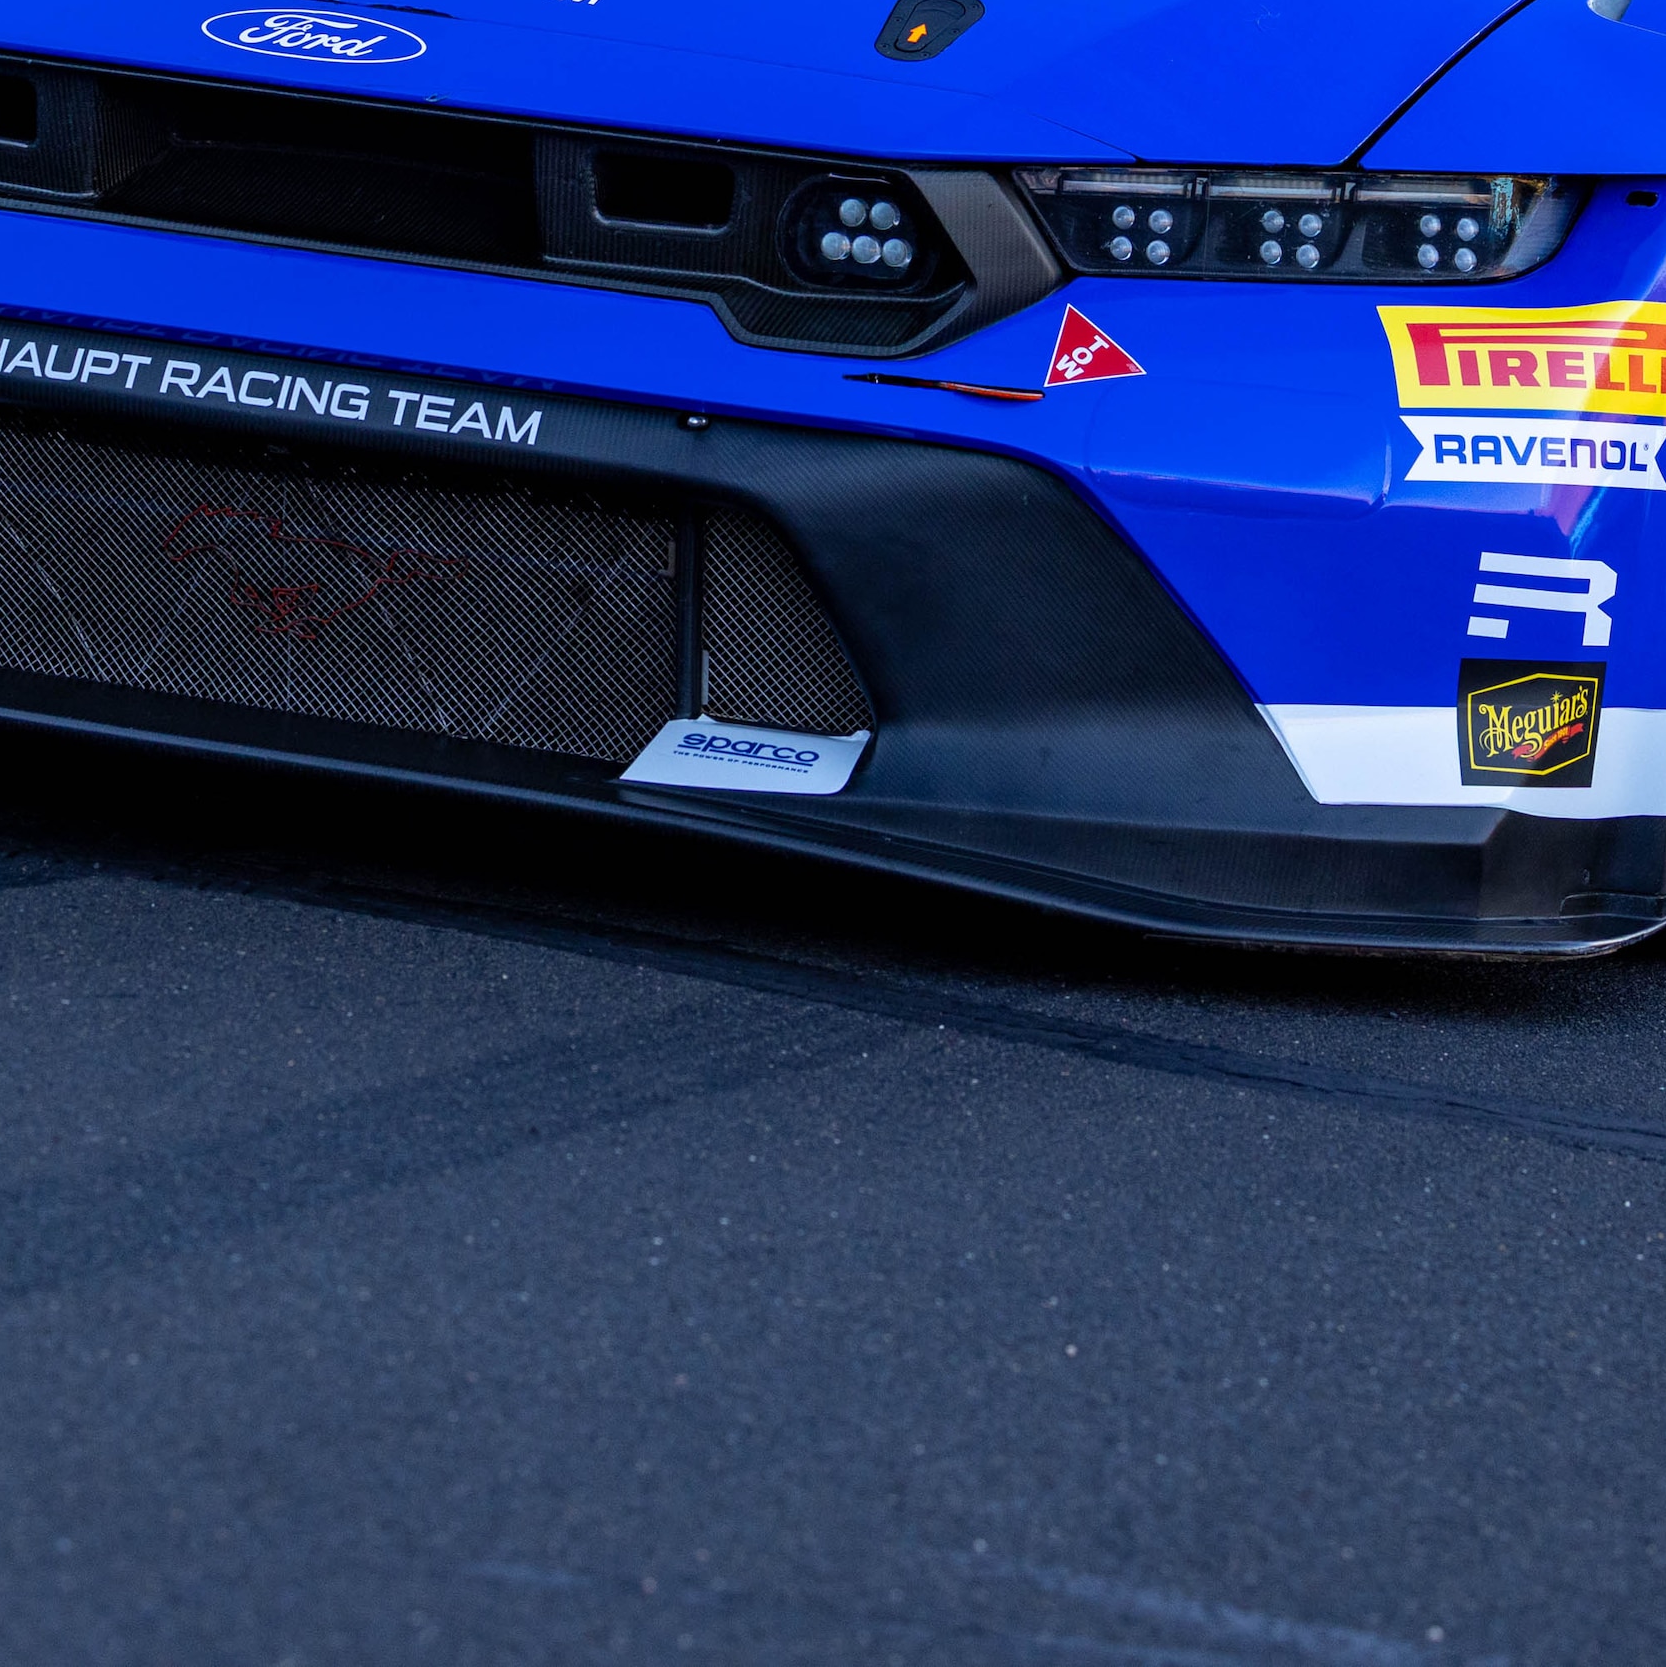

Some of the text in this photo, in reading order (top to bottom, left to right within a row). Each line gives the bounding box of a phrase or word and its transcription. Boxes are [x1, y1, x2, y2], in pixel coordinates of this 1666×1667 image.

[261, 9, 383, 58] Ford
[1056, 335, 1110, 380] TOW
[159, 360, 370, 420] RACING
[384, 389, 542, 445] TEAM
[1479, 685, 1589, 758] Meguiar's
[682, 733, 820, 763] sparco
